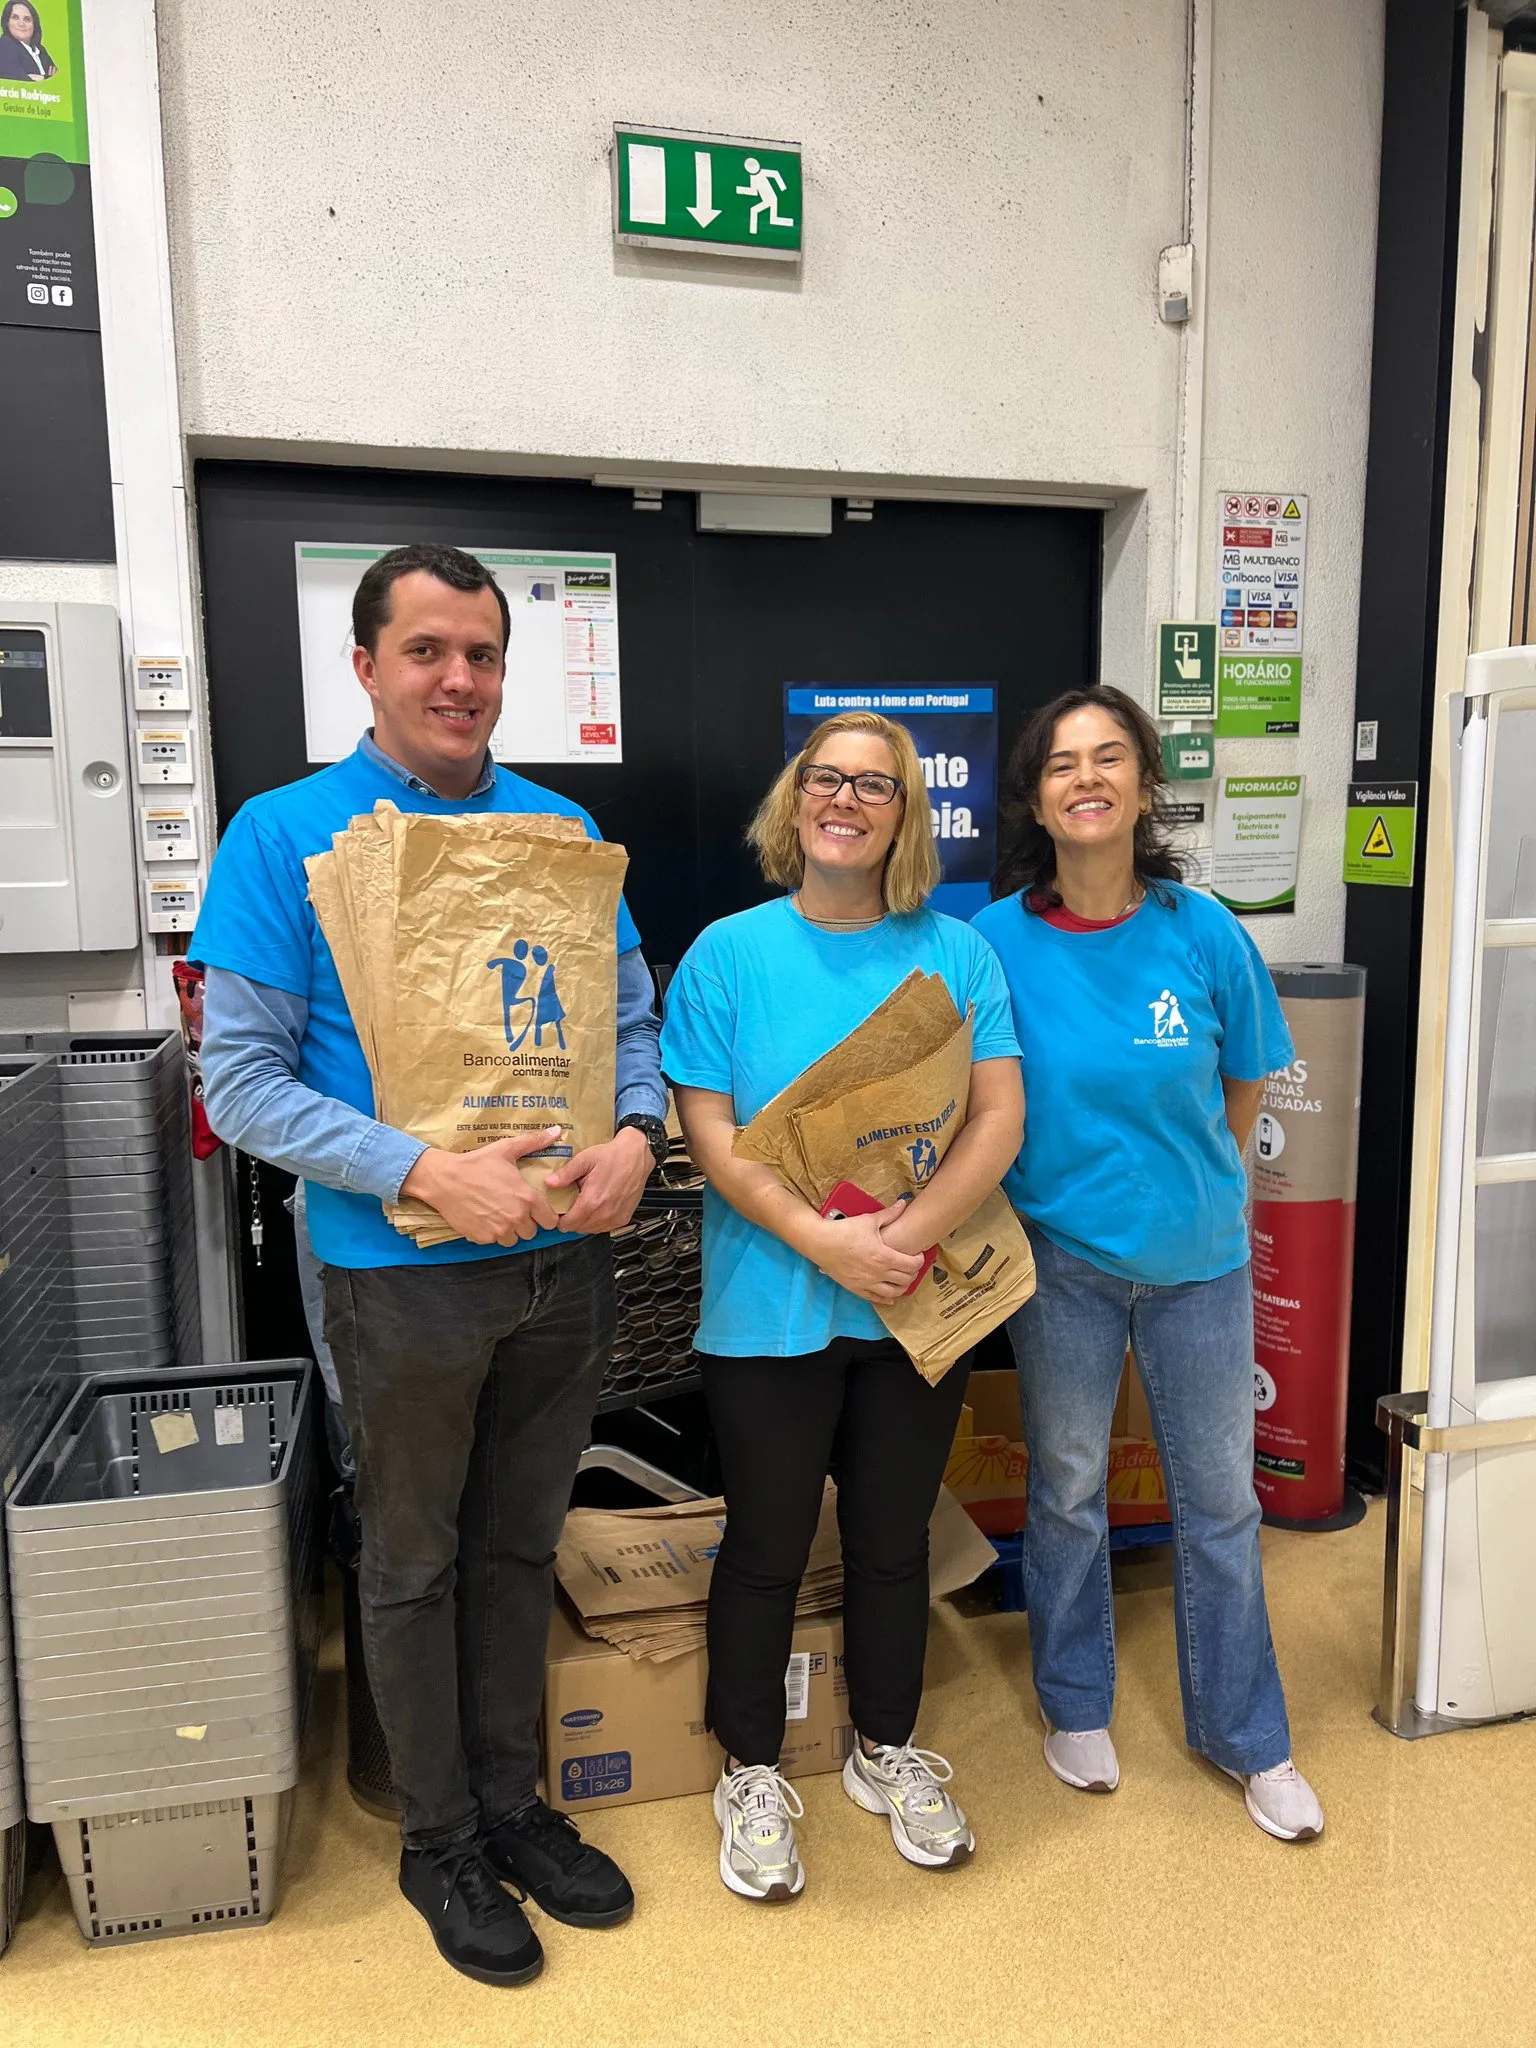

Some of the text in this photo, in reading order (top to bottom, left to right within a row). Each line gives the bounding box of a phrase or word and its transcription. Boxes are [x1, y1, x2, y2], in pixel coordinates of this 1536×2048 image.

[21, 88, 60, 104] Rodrigues
[4, 103, 51, 117] Gestor de Loja
[29, 248, 53, 256] Também
[1244, 555, 1300, 566] MULTIBANCO
[1278, 573, 1297, 582] VISA
[1251, 592, 1271, 600] VISA
[1224, 660, 1291, 679] HORÁRIO
[815, 694, 969, 707] Luta contra a fome em Portugal
[1228, 779, 1298, 794] INFORMAÇÃO
[1355, 790, 1386, 803] Vigilância
[1232, 813, 1287, 822] Equipamentos
[463, 1053, 571, 1068] Bancoalimentar
[512, 1068, 570, 1078] contra a fome
[463, 1095, 518, 1109] ALIMENTE
[522, 1095, 547, 1108] ESTA
[1269, 1096, 1322, 1113] USADAS
[457, 1123, 471, 1131] ESTE
[473, 1123, 488, 1131] SACO
[489, 1122, 499, 1130] VAI
[500, 1122, 511, 1130] SER
[512, 1122, 540, 1131] ENTREGUE
[856, 1124, 913, 1150] ALIMENTE
[914, 1117, 942, 1133] ESTA
[1262, 1293, 1300, 1309] BATERIAS
[570, 1766, 579, 1777] 8
[573, 1777, 625, 1793] S 3x26
